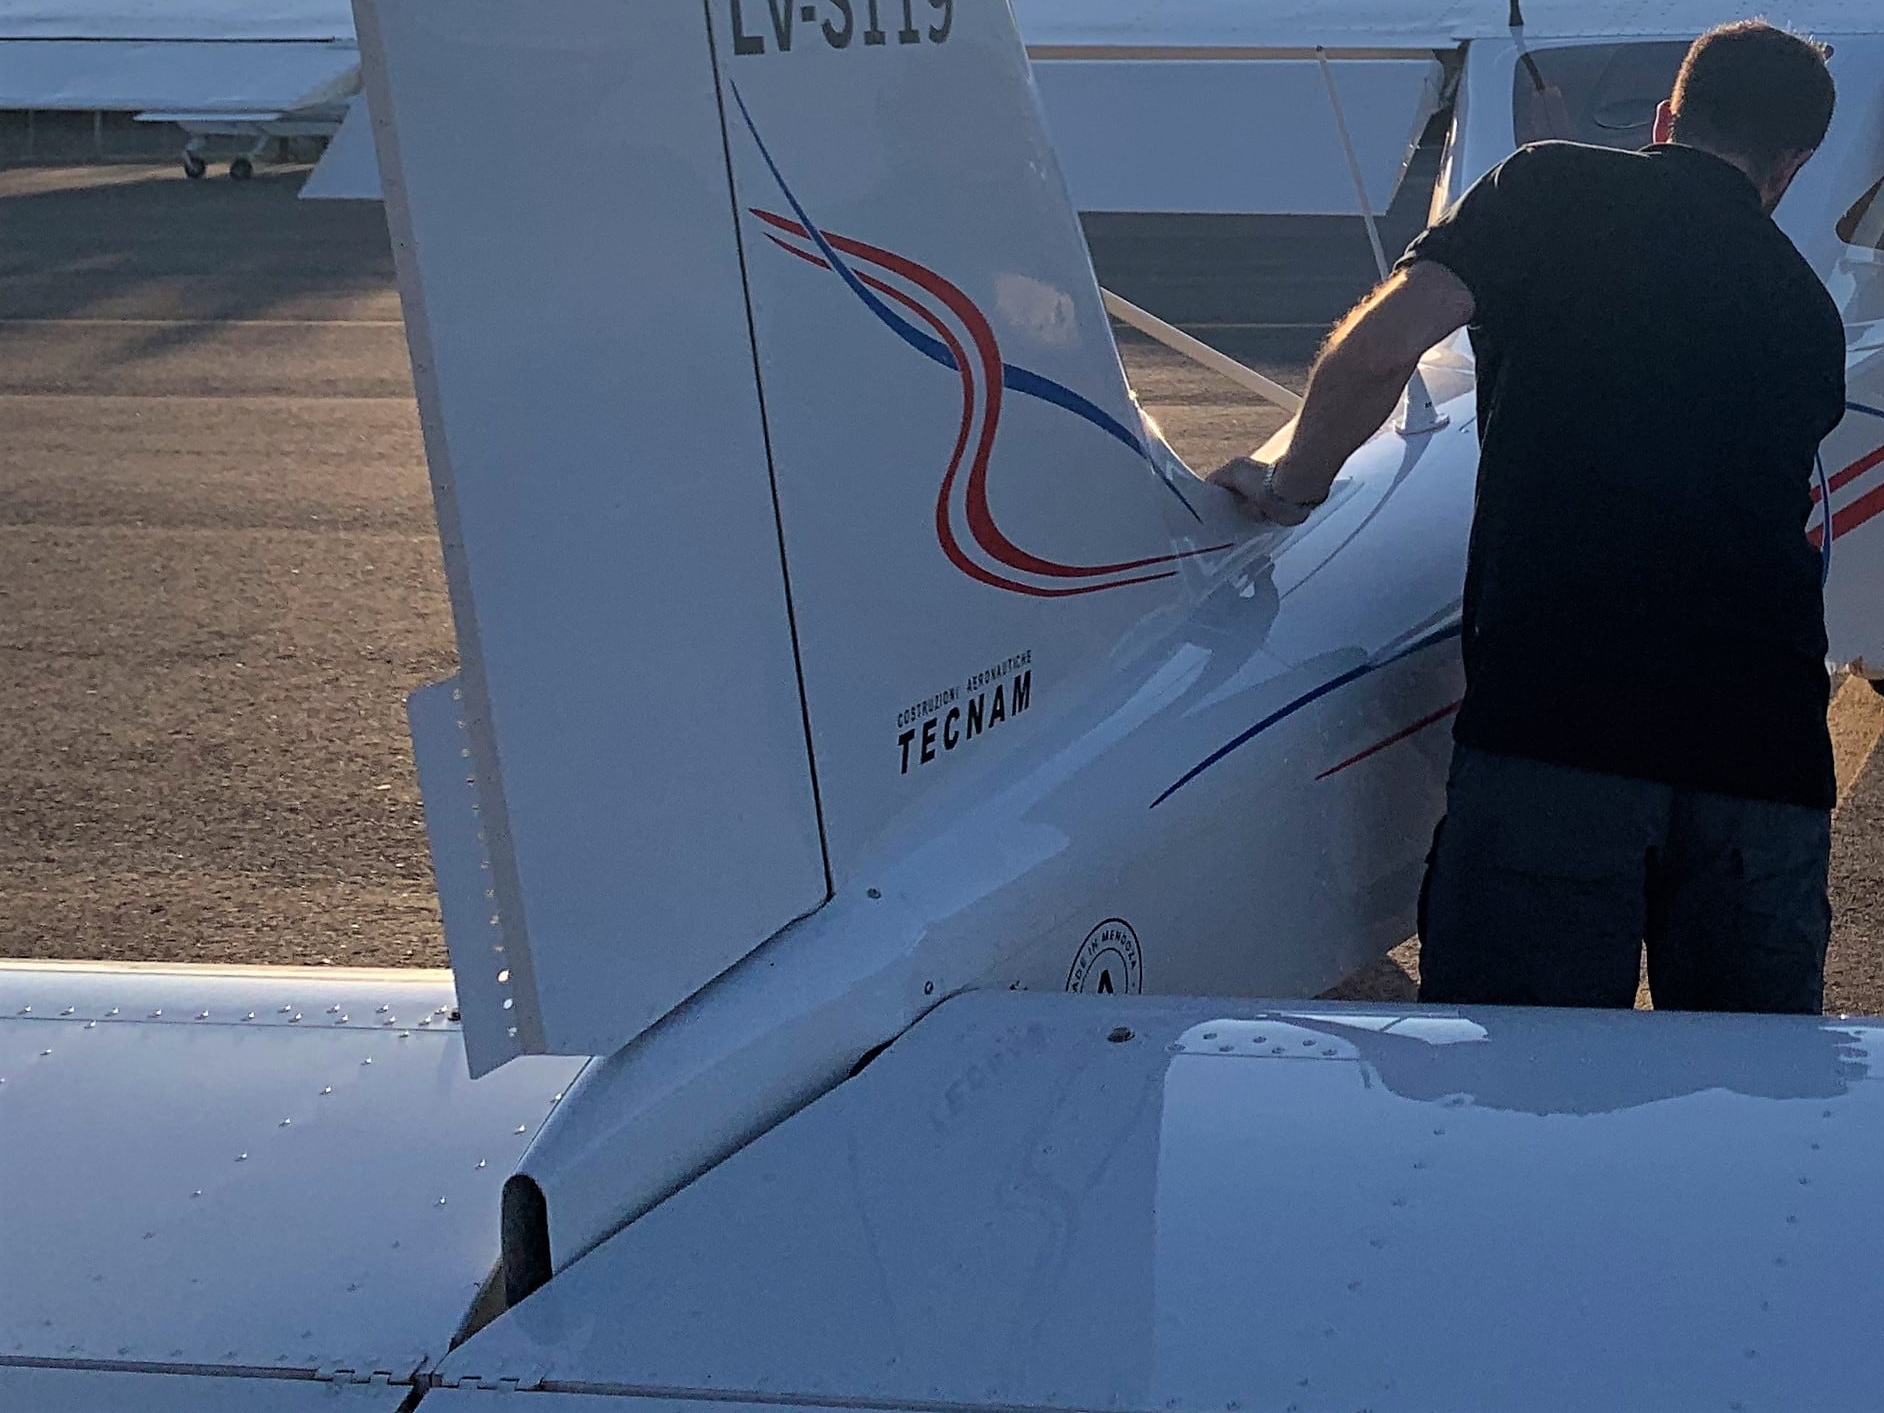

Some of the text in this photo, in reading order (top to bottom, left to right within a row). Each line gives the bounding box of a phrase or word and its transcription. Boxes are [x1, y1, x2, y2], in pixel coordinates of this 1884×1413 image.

[897, 687, 960, 728] COSTRUZIONI
[898, 670, 1032, 775] TECNAM
[1101, 929, 1136, 970] MENDOZA
